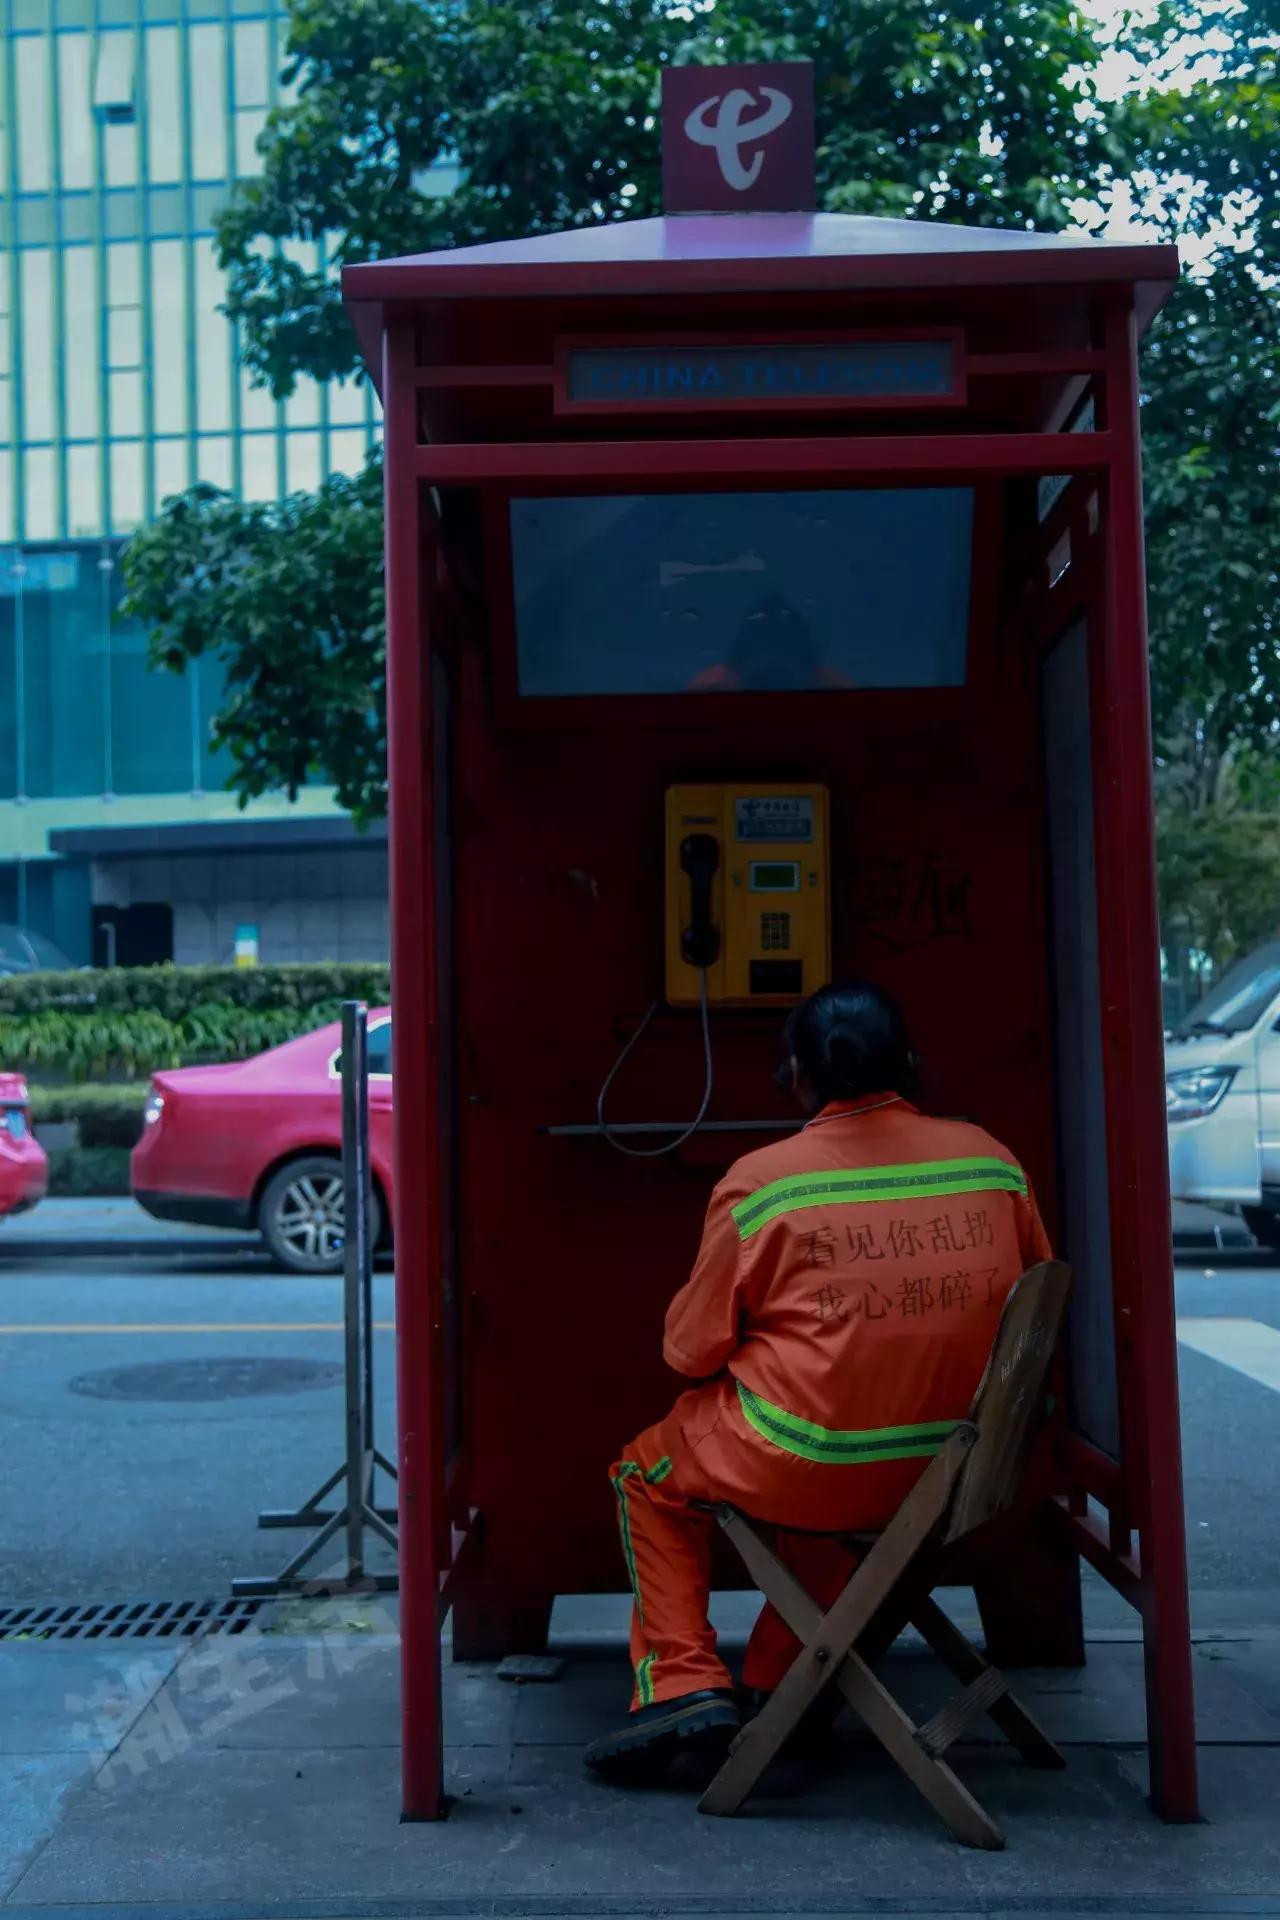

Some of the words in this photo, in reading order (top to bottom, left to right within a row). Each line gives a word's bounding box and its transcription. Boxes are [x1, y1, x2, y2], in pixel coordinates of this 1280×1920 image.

[591, 362, 725, 391] CHINA
[797, 1210, 995, 1268] 看见你乱扔
[809, 1268, 998, 1324] 我心都碎了
